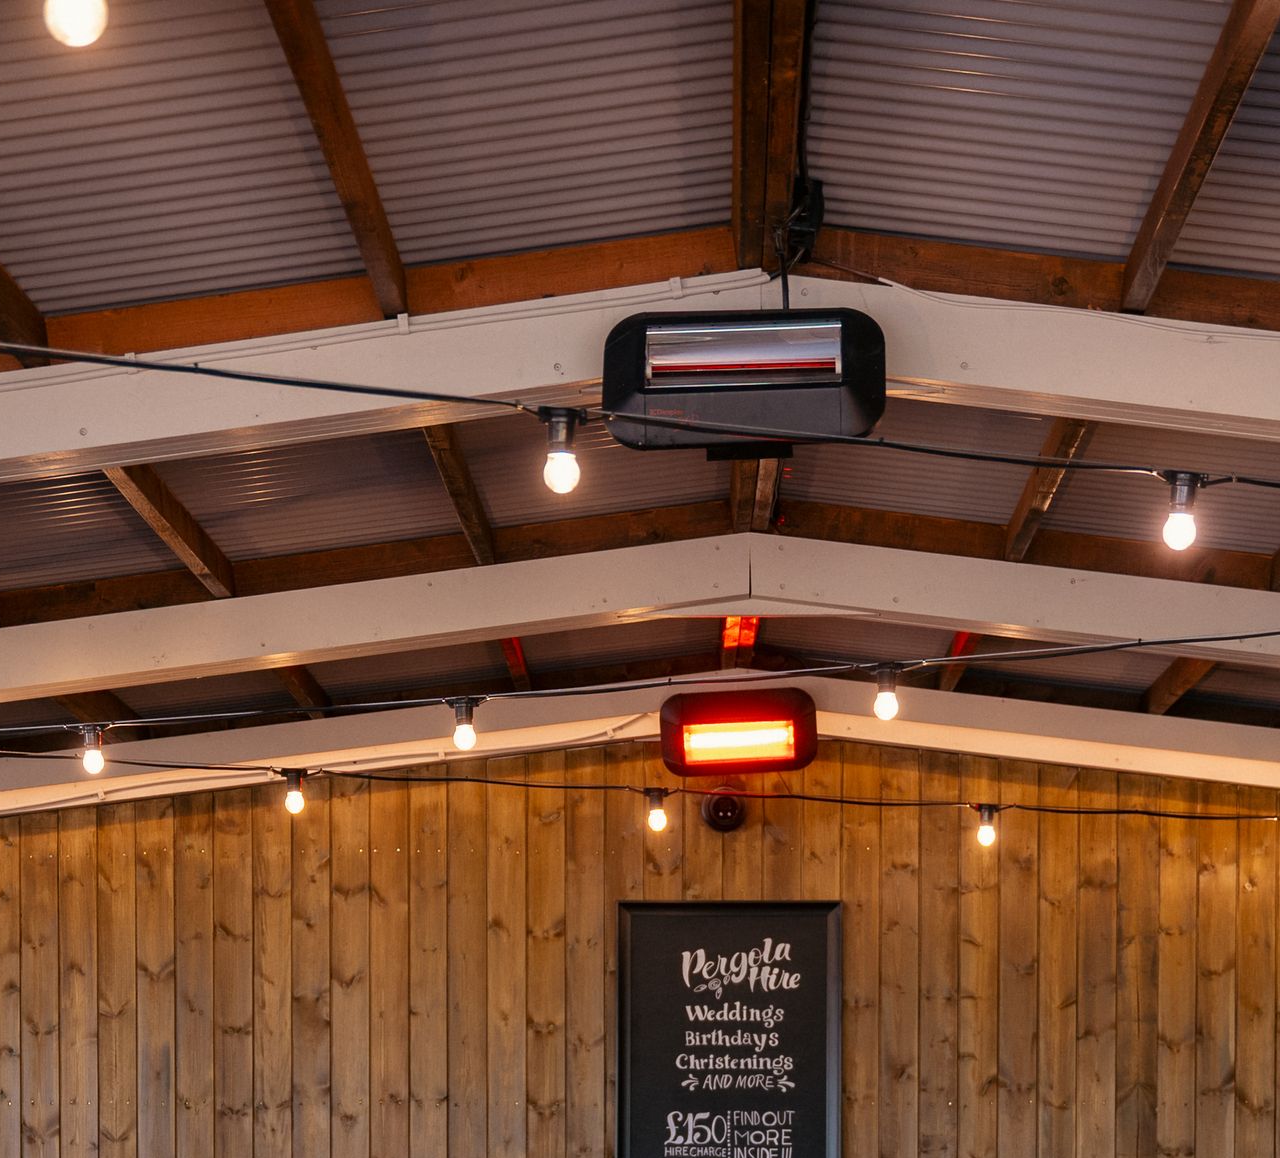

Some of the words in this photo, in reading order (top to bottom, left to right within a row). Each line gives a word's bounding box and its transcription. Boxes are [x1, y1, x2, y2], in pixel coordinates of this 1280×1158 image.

[681, 937, 791, 988] Pergola
[748, 966, 801, 993] Hire
[685, 1001, 785, 1028] Weddings
[685, 1029, 780, 1053] Birthdays
[675, 1053, 794, 1075] Christenings
[702, 1074, 733, 1091] AND
[735, 1074, 775, 1091] MORE
[664, 1110, 728, 1145] £150
[733, 1110, 761, 1126] FIND
[761, 1110, 796, 1127] OUT
[734, 1129, 793, 1146] MORE
[664, 1146, 689, 1157] HIRE
[689, 1146, 727, 1158] CHARGE
